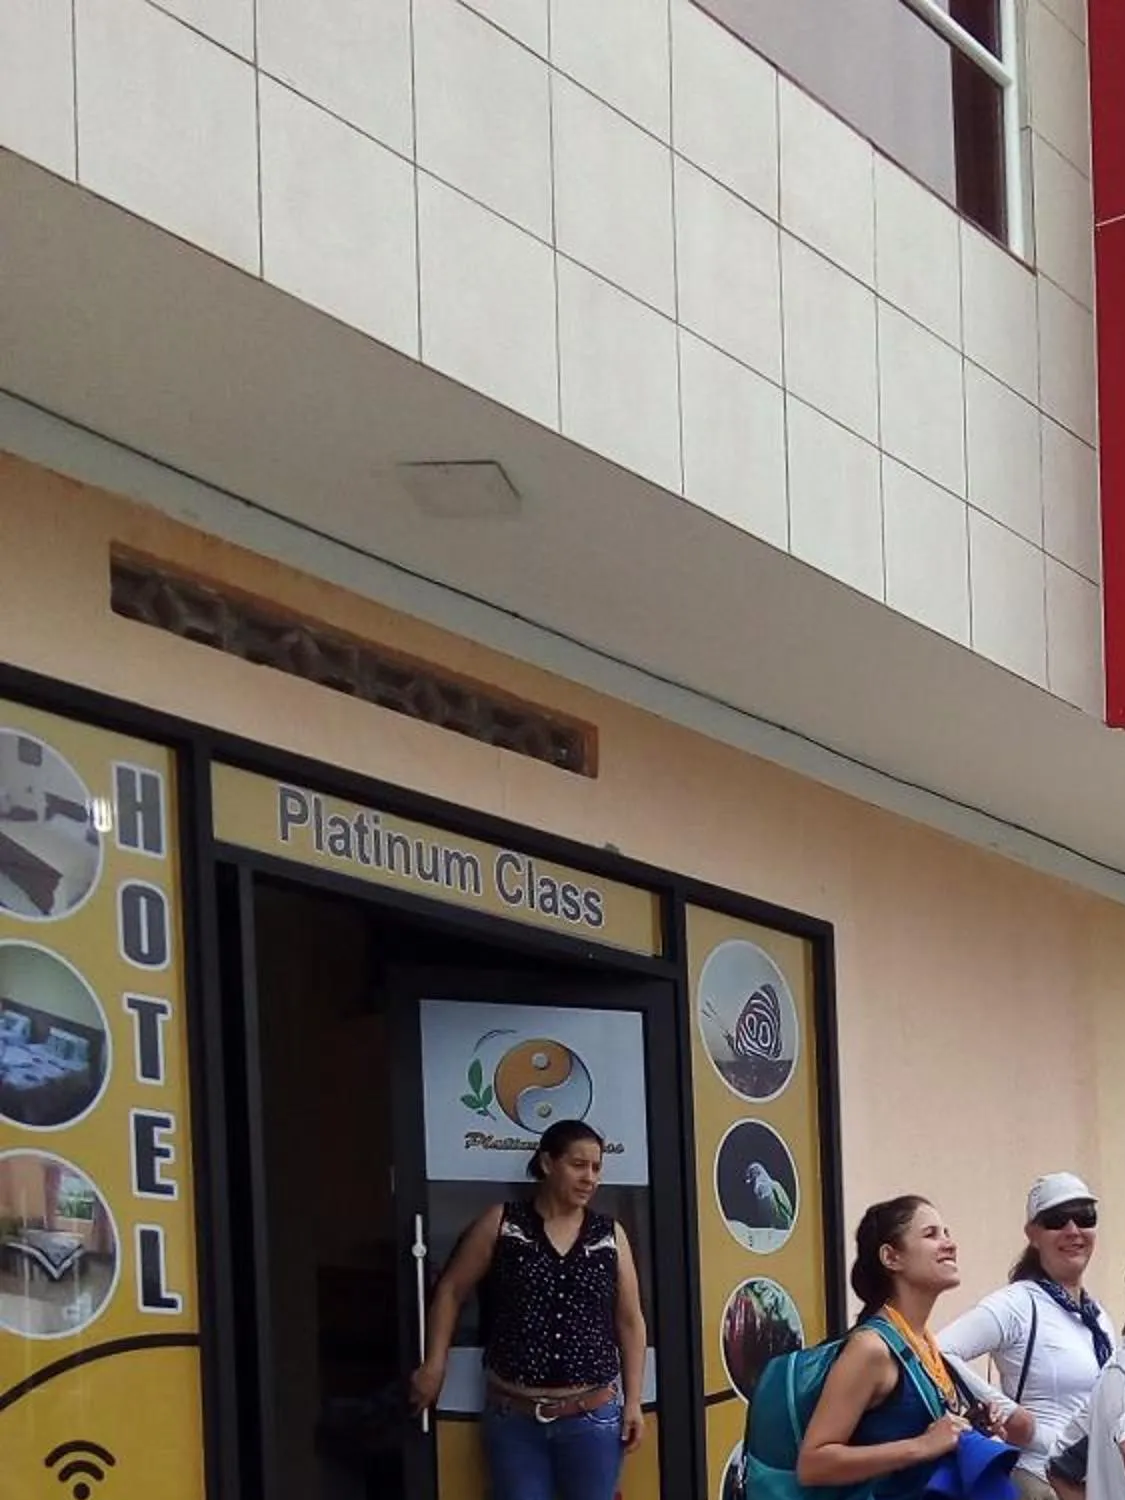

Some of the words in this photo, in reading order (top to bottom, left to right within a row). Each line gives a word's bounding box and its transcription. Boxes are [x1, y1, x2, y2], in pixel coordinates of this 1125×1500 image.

[278, 784, 482, 896] Platinum
[494, 851, 605, 928] Class
[114, 763, 181, 1312] HOTEL
